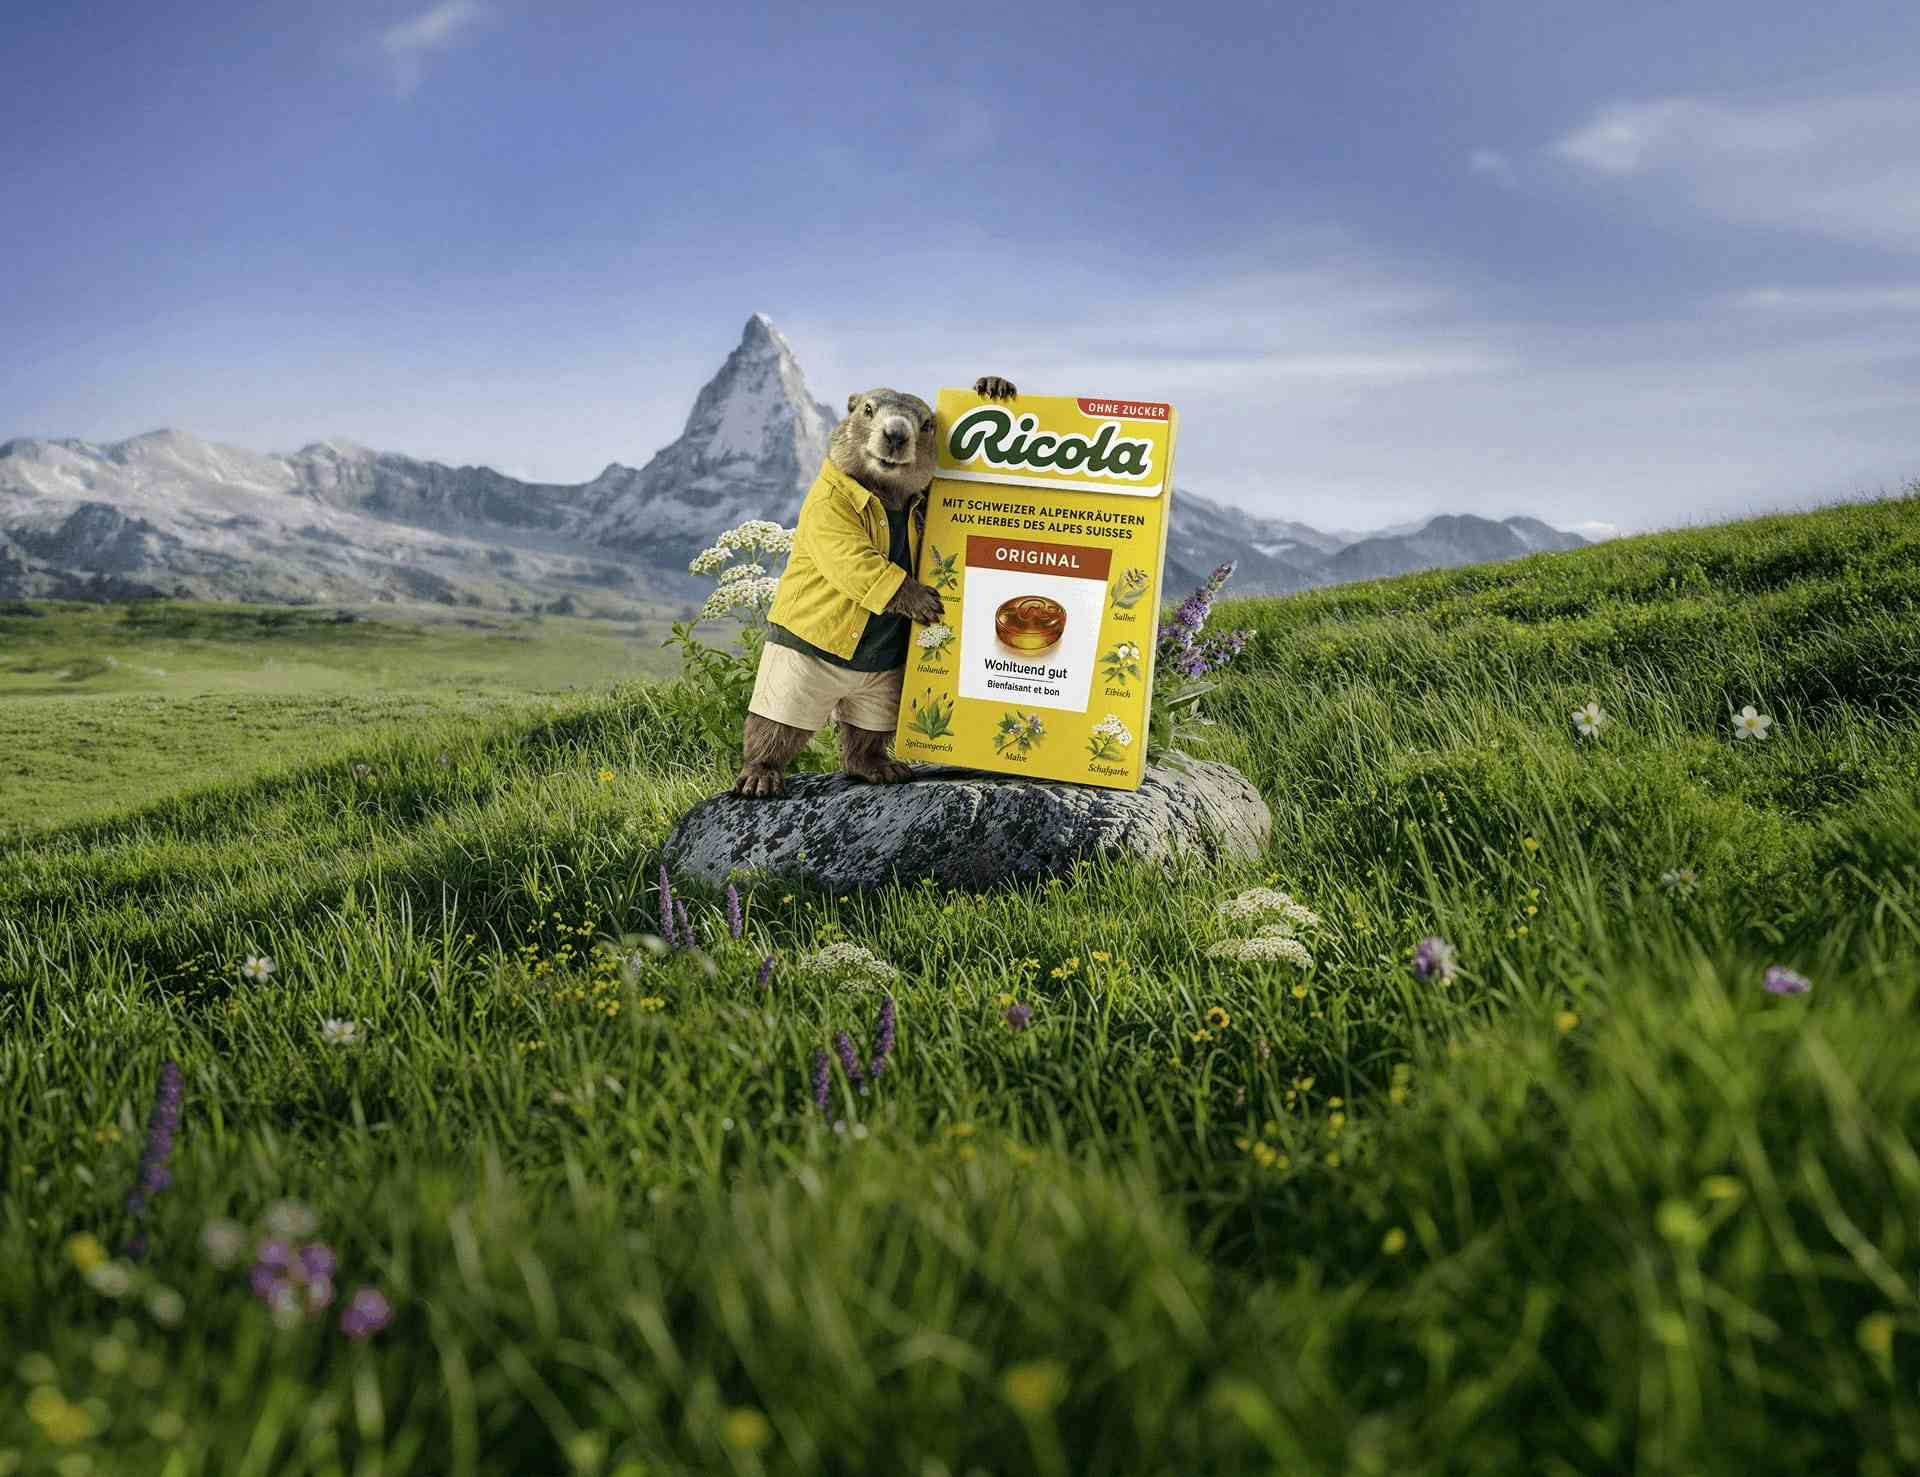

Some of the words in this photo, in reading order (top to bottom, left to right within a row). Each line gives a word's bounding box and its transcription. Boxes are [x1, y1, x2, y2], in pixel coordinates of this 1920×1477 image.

[1088, 402, 1119, 415] OHNE
[1122, 405, 1165, 417] ZUCKER
[950, 409, 1148, 475] Ricola
[942, 498, 964, 508] MIT
[967, 500, 1036, 516] SCHWEIZER
[1039, 507, 1145, 525] ALPENKRÄUTERN
[951, 513, 975, 524] AUX
[977, 515, 1020, 529] HERBES
[1023, 520, 1046, 532] DES
[1047, 522, 1083, 535] ALPES
[1085, 526, 1133, 539] SUISSES
[995, 547, 1080, 569] ORIGINAL
[916, 664, 950, 676] Holunder
[984, 658, 1046, 677] Wohltuend
[1048, 667, 1068, 680] gut
[987, 679, 1032, 694] Bienfaisant
[1033, 686, 1042, 694] et
[1044, 687, 1060, 697] bon
[1104, 687, 1132, 698] Eibisch
[1004, 752, 1028, 763] Malve
